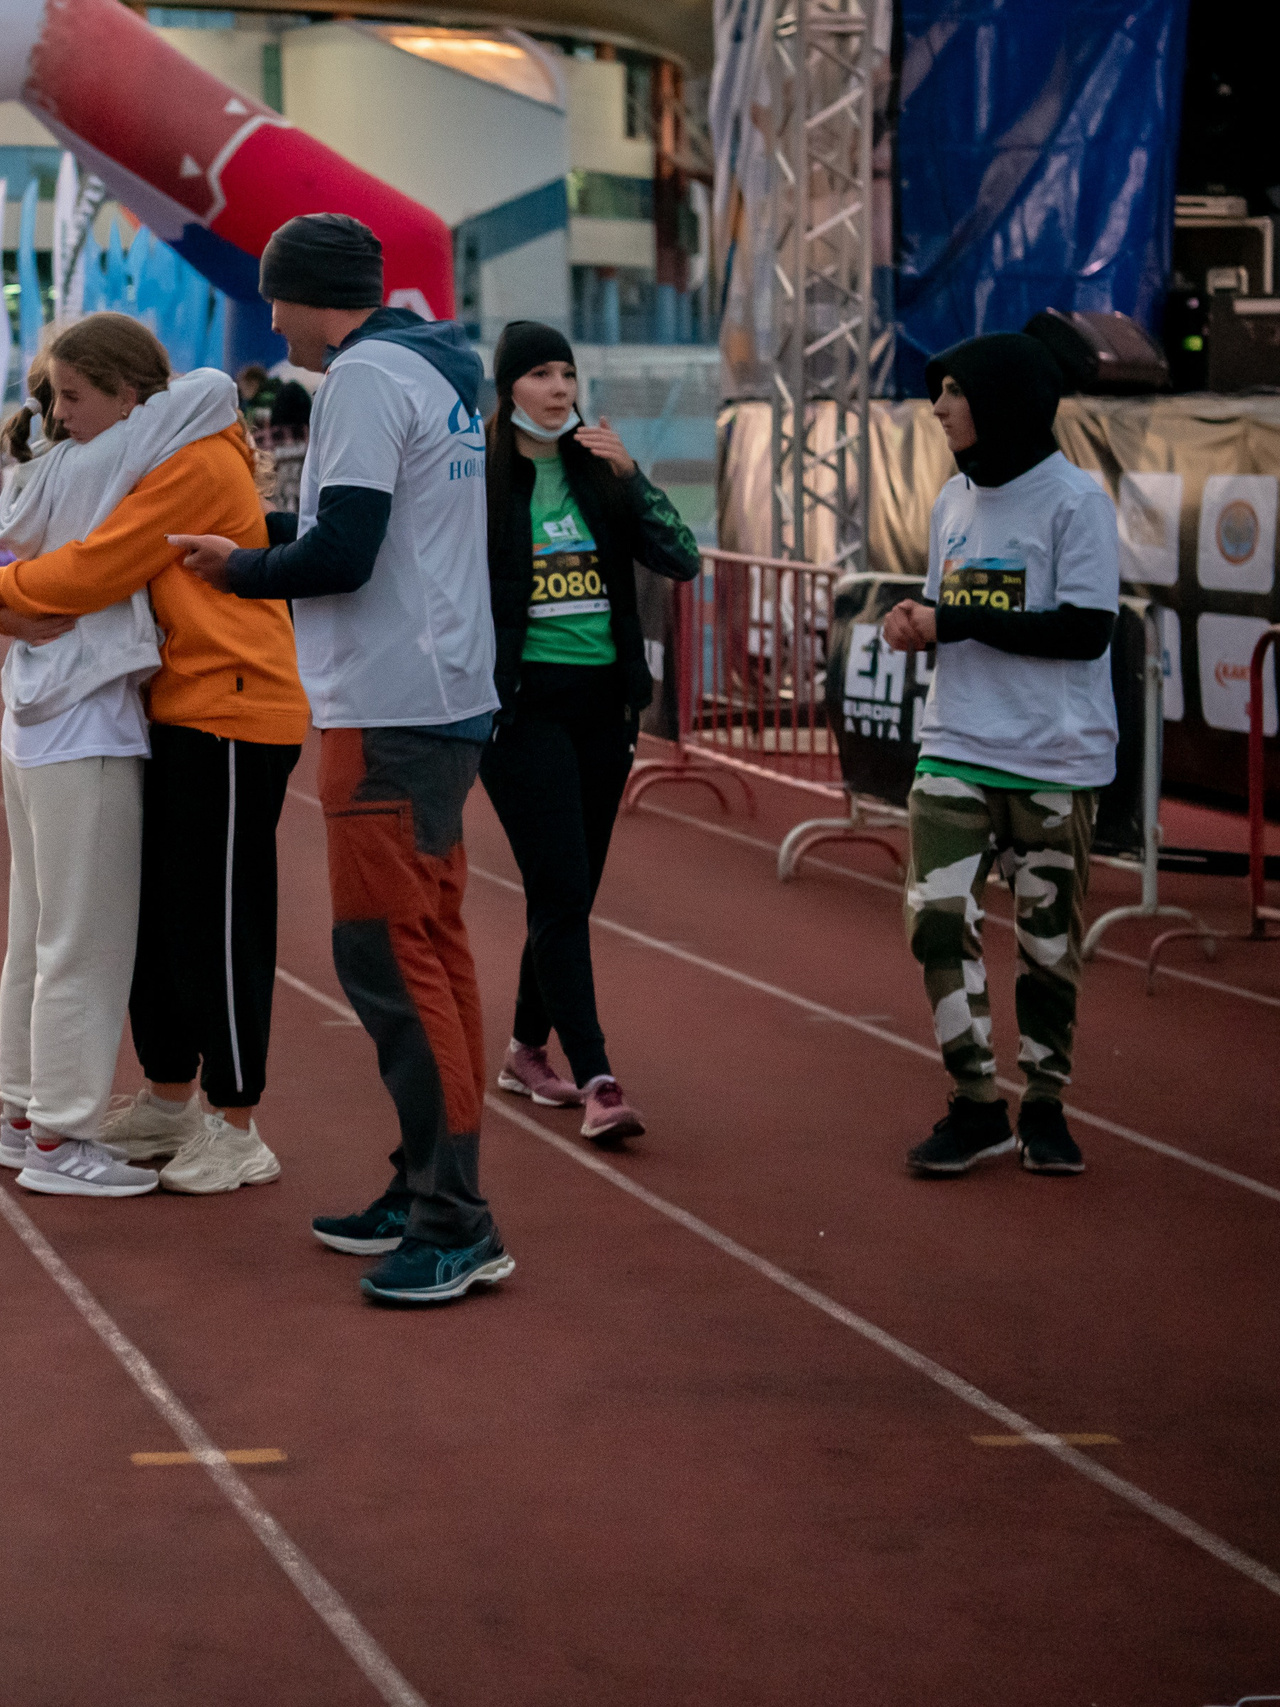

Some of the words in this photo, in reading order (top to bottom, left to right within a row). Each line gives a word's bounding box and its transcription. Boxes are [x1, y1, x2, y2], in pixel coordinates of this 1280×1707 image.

[531, 570, 601, 600] 2080
[943, 590, 1010, 611] 2079
[843, 699, 901, 723] EUROPE
[844, 717, 900, 741] ASIA
